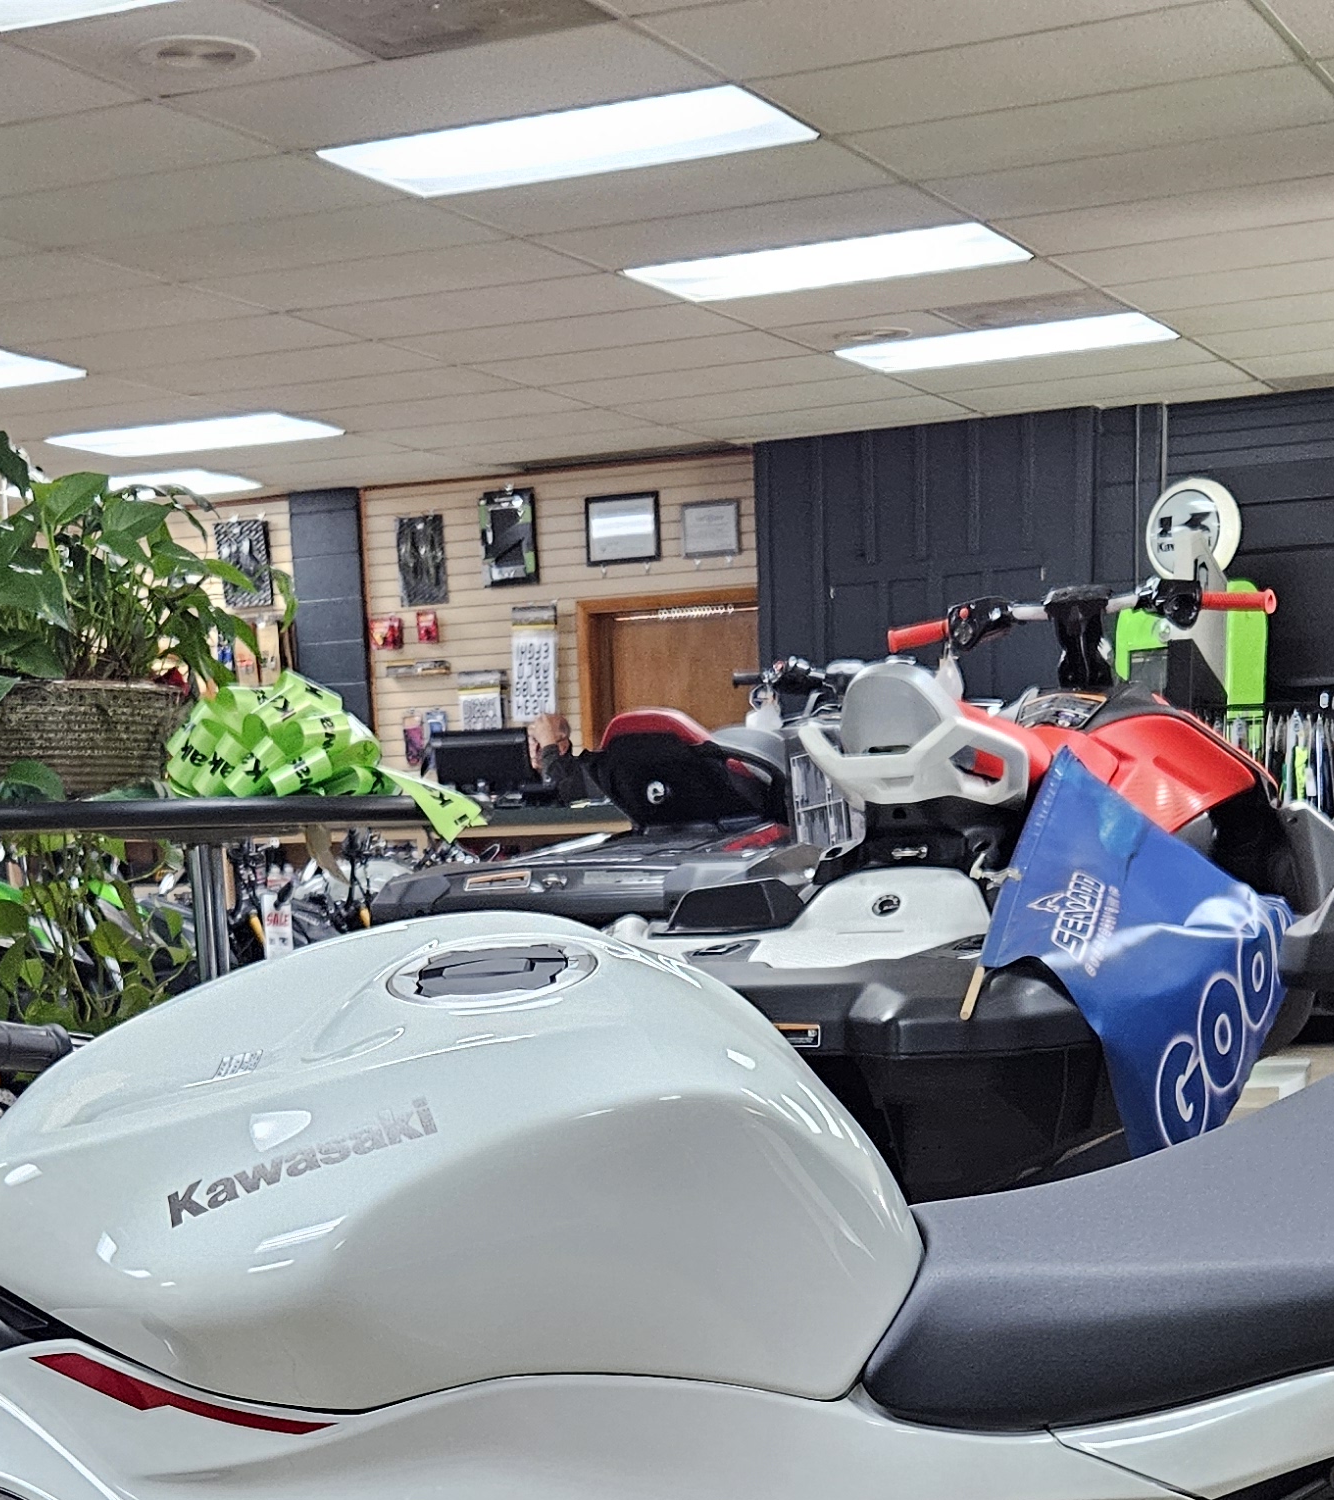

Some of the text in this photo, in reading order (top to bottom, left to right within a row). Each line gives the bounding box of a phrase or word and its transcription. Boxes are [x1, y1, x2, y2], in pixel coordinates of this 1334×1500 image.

[267, 912, 290, 927] SALE
[1156, 905, 1285, 1147] GOO
[167, 1096, 438, 1228] Kawasaki
